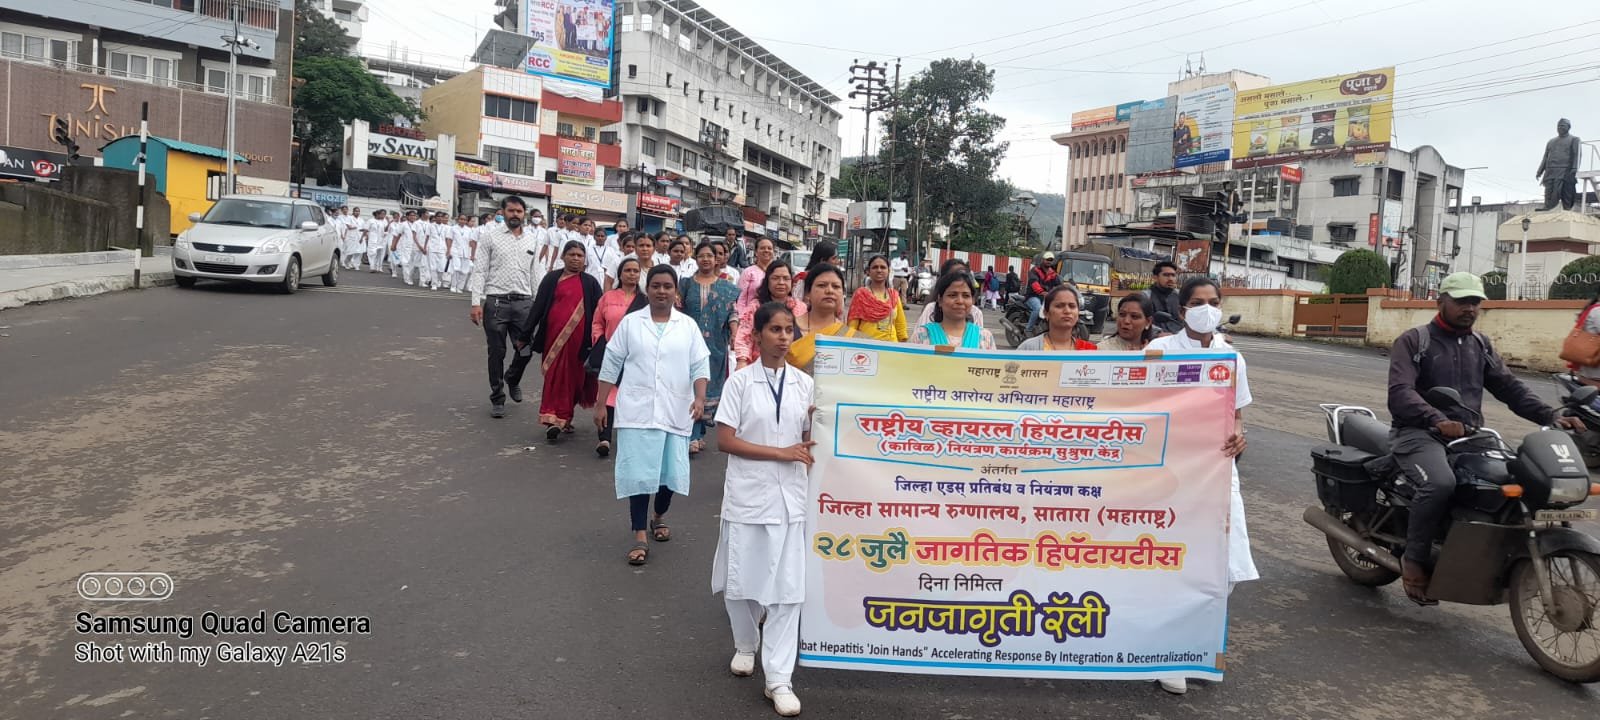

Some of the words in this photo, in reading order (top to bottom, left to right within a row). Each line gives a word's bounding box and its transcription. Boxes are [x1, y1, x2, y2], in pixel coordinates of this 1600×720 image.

[528, 56, 551, 68] RCC
[383, 137, 436, 160] SAYAJI
[968, 366, 1001, 378] महाराष्ट्र
[1020, 369, 1048, 378] शासन
[912, 385, 947, 403] राष्ट्रीय
[951, 388, 993, 403] आरोग्य
[997, 391, 1048, 405] अभियान
[1053, 394, 1096, 409] महाराष्ट्र
[859, 412, 924, 437] राष्ट्रीय
[929, 420, 1014, 438] व्हायरल
[1020, 417, 1143, 441] हिपॅटायटीस
[881, 438, 943, 454] (काविळ)
[948, 441, 994, 455] नियंत्रण
[999, 443, 1053, 457] कार्यक्रम
[1097, 445, 1121, 459] केंद्र
[981, 464, 1018, 476] अंतर्गत
[894, 475, 932, 493] जिल्हा
[936, 482, 966, 498] एडस्
[969, 477, 1012, 494] प्रतिबंध
[1017, 484, 1026, 495] व
[1030, 480, 1074, 497] नियंत्रण
[1078, 486, 1102, 498] कक्ष
[818, 493, 872, 519] जिल्हा
[878, 502, 941, 518] सामान्य
[945, 504, 1027, 524] रुग्णालय,
[1033, 506, 1090, 523] सातारा
[1097, 506, 1177, 529] (महाराष्ट्र)
[817, 536, 851, 557] २८
[859, 531, 909, 568] जुलै
[915, 532, 1030, 562] जागतिक
[1036, 534, 1182, 567] हिपॅटायटीस
[918, 573, 948, 592] दिना
[953, 573, 1003, 592] निमित्त
[865, 591, 1038, 645] जनजागृती
[1042, 592, 1107, 640] रॅली
[820, 641, 864, 655] Hepatitis
[867, 643, 890, 656] 'Join
[892, 646, 928, 658] Hands"
[931, 648, 992, 663] Accelerating
[995, 650, 1042, 663] Response
[1045, 651, 1057, 663] By
[1060, 651, 1114, 664] Integration
[1116, 653, 1125, 663] &
[1127, 651, 1208, 663] Decentralization"
